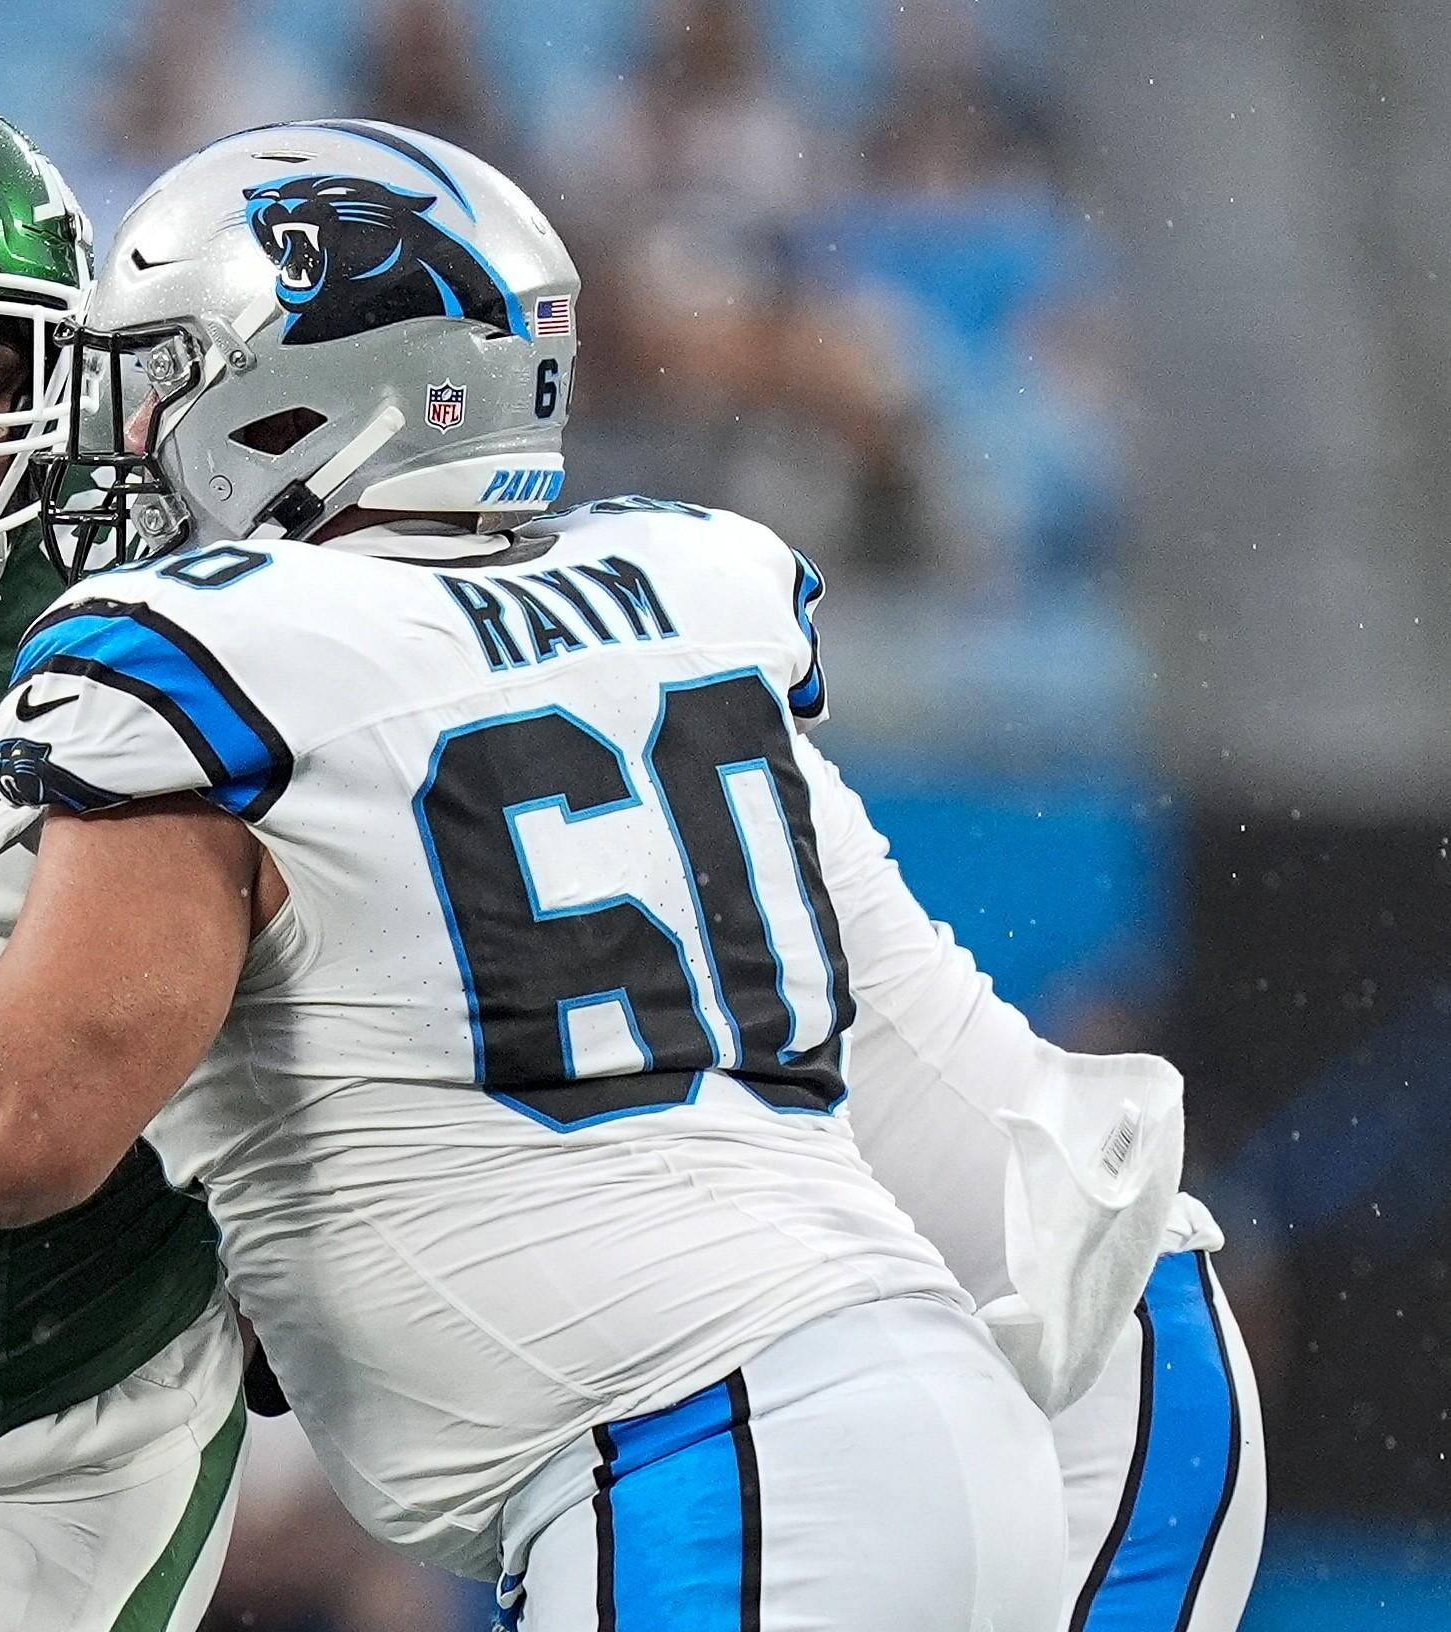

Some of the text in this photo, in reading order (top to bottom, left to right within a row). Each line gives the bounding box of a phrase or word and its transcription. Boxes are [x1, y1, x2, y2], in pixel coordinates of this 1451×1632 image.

[430, 403, 460, 425] NFL
[433, 555, 679, 672] RAYM
[411, 665, 857, 1134] 60
